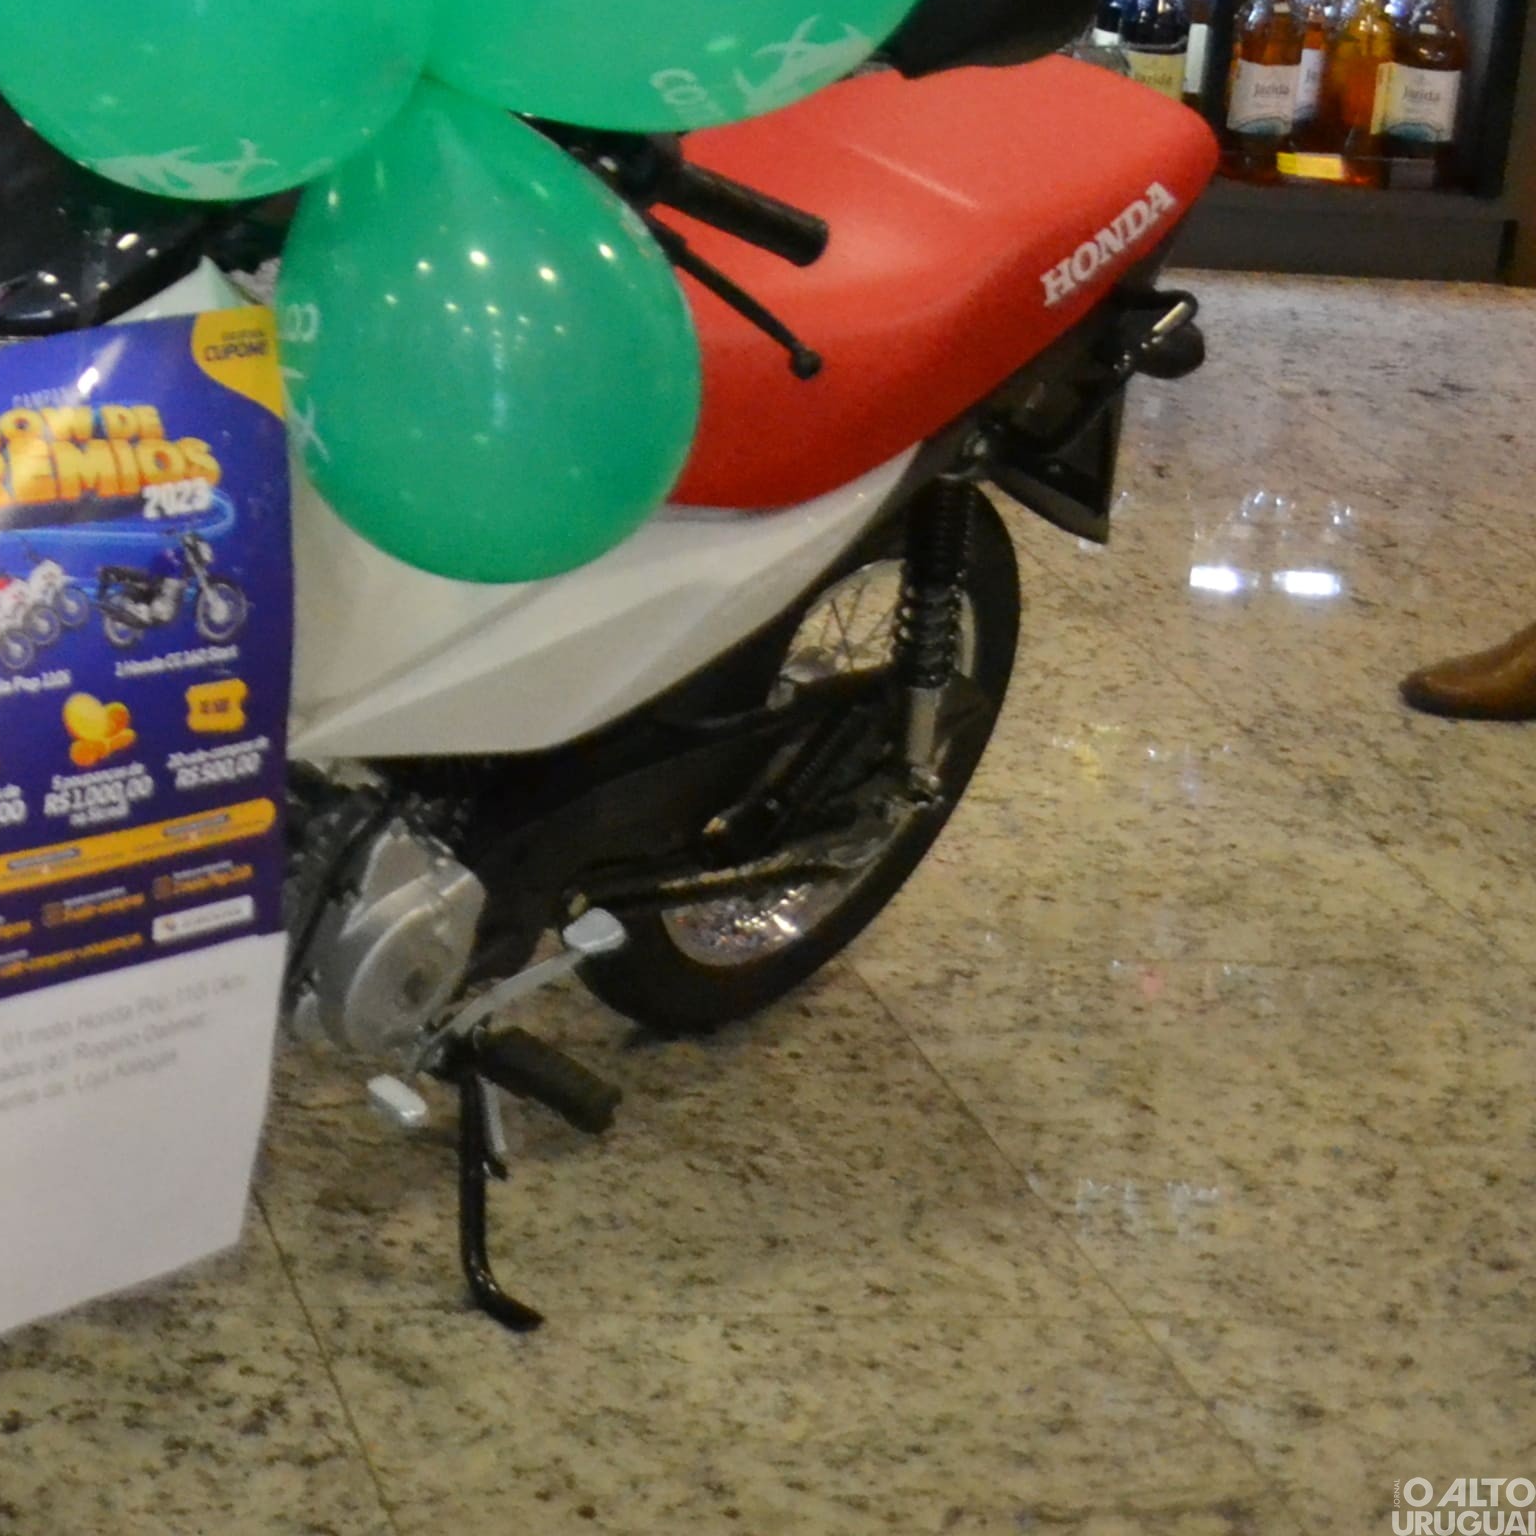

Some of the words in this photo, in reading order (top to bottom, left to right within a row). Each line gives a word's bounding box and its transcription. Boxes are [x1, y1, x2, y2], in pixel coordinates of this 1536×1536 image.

[1040, 181, 1177, 308] HONDA
[101, 404, 165, 440] DE
[142, 477, 213, 520] 2023
